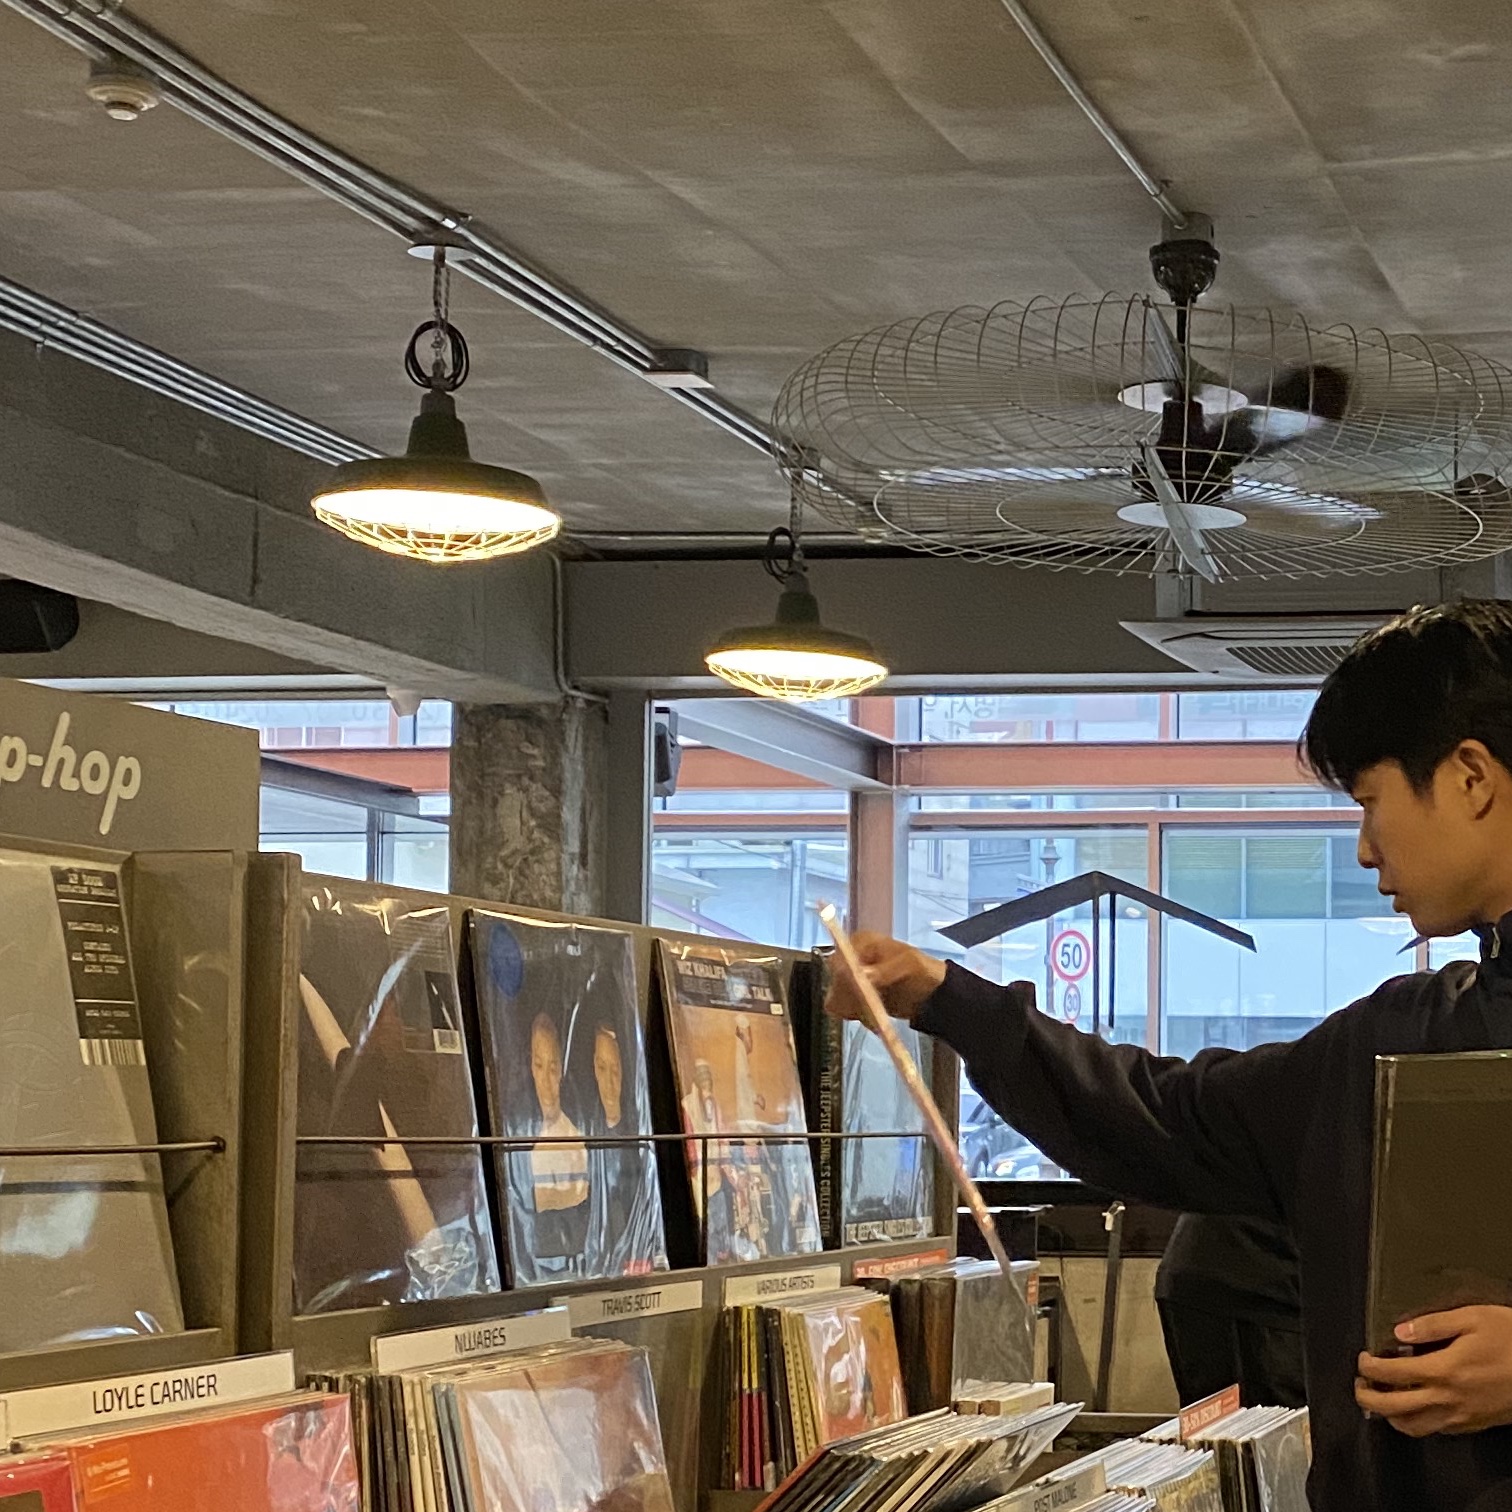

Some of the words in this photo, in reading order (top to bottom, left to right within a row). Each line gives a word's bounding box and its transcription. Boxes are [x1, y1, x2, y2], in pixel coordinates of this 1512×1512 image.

[1060, 943, 1082, 969] 50
[1067, 993, 1078, 1012] 30
[602, 1296, 633, 1318] TRAVIS
[634, 1291, 661, 1312] SCOTT
[92, 1384, 145, 1414] LOYLE
[149, 1373, 219, 1405] CARNER
